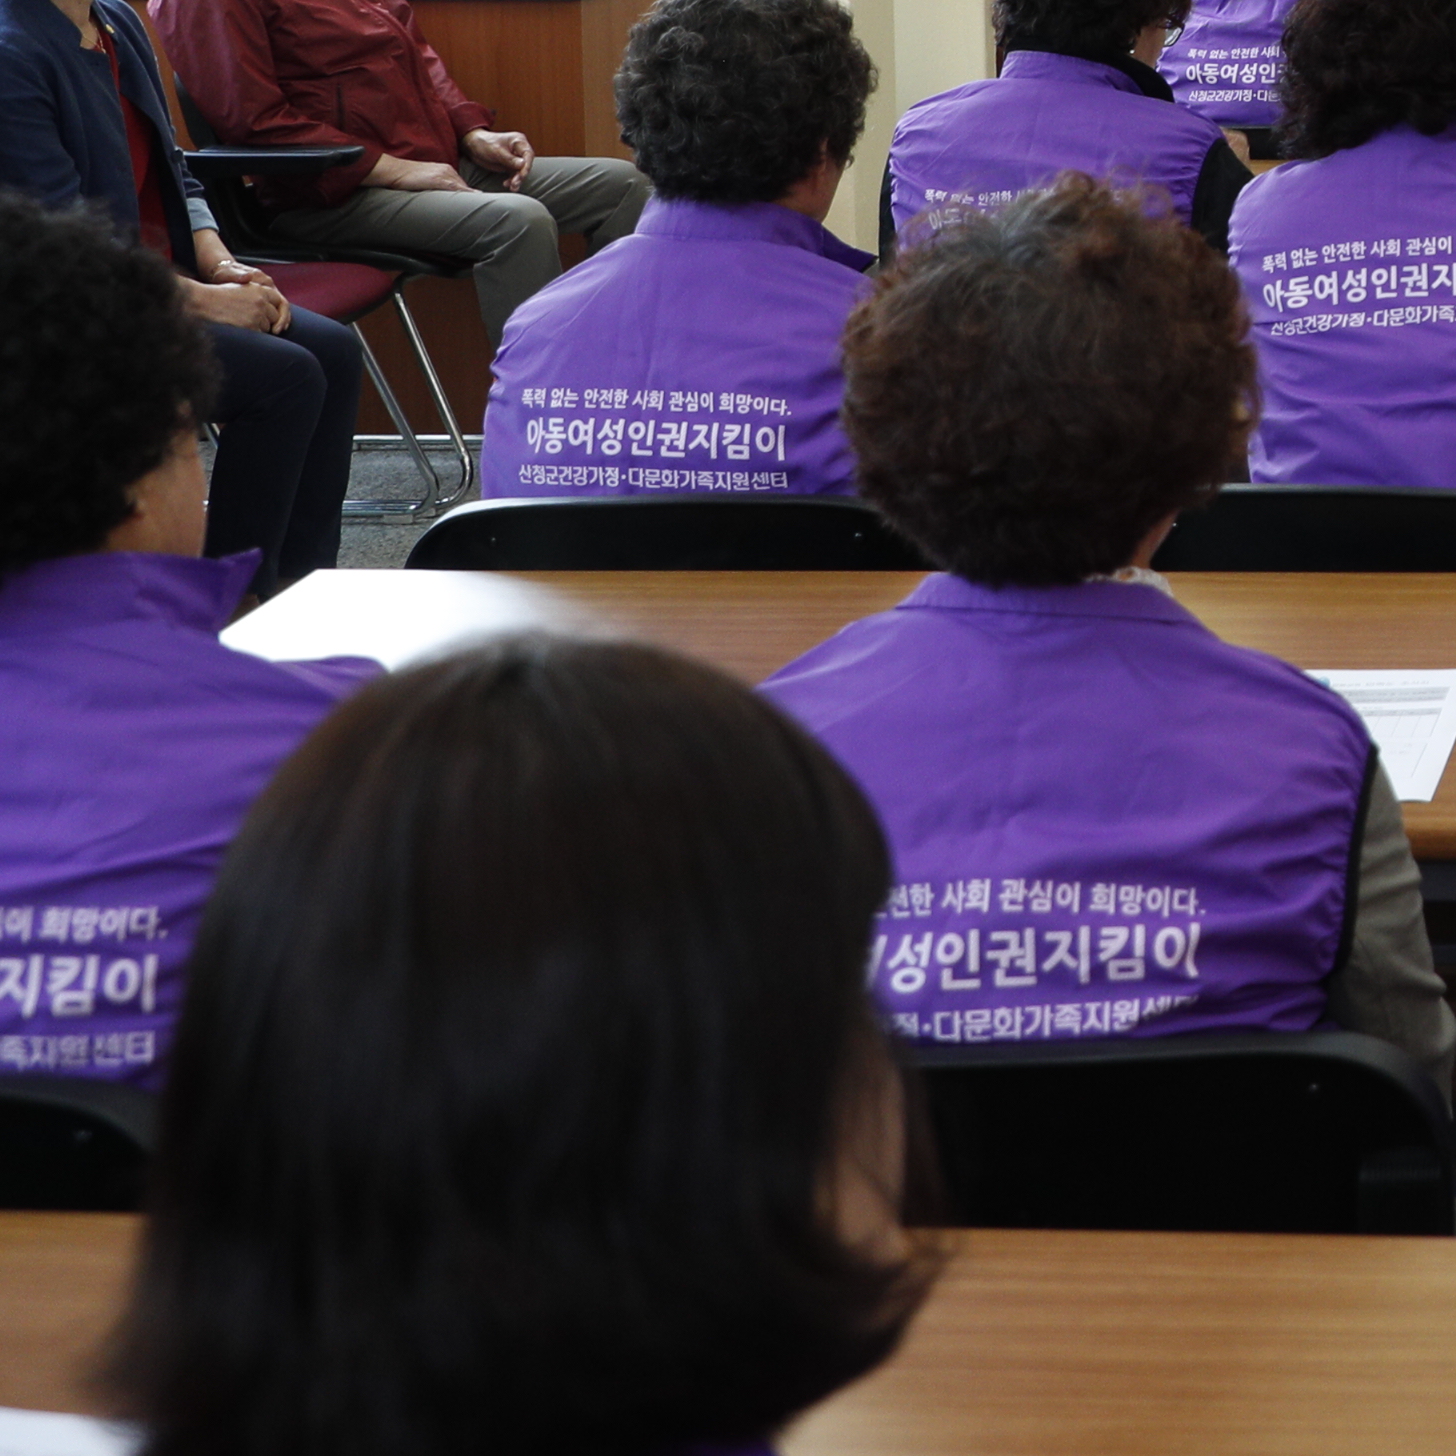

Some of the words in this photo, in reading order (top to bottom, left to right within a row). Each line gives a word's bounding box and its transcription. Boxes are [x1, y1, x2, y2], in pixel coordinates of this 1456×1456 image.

[1187, 48, 1208, 59] 폭력
[1230, 47, 1260, 59] 안전한
[1261, 46, 1281, 58] 사회
[1262, 251, 1287, 274] 폭력
[1290, 247, 1319, 269] 없는
[1322, 240, 1367, 264] 안전한
[1370, 237, 1402, 258] 사회
[1405, 234, 1453, 256] 관심이
[521, 387, 546, 409] 폭력
[550, 387, 580, 409] 없는
[583, 387, 629, 410] 안전한
[632, 389, 665, 412] 사회
[668, 390, 715, 414] 관심이
[718, 391, 793, 417] 희망이다.
[527, 416, 787, 462] 아동여성인권지킴이
[941, 877, 992, 915] 사회
[999, 877, 1082, 915] 관심이
[1089, 880, 1207, 918] 희망이다.
[866, 921, 1201, 994] 성인권지킴이
